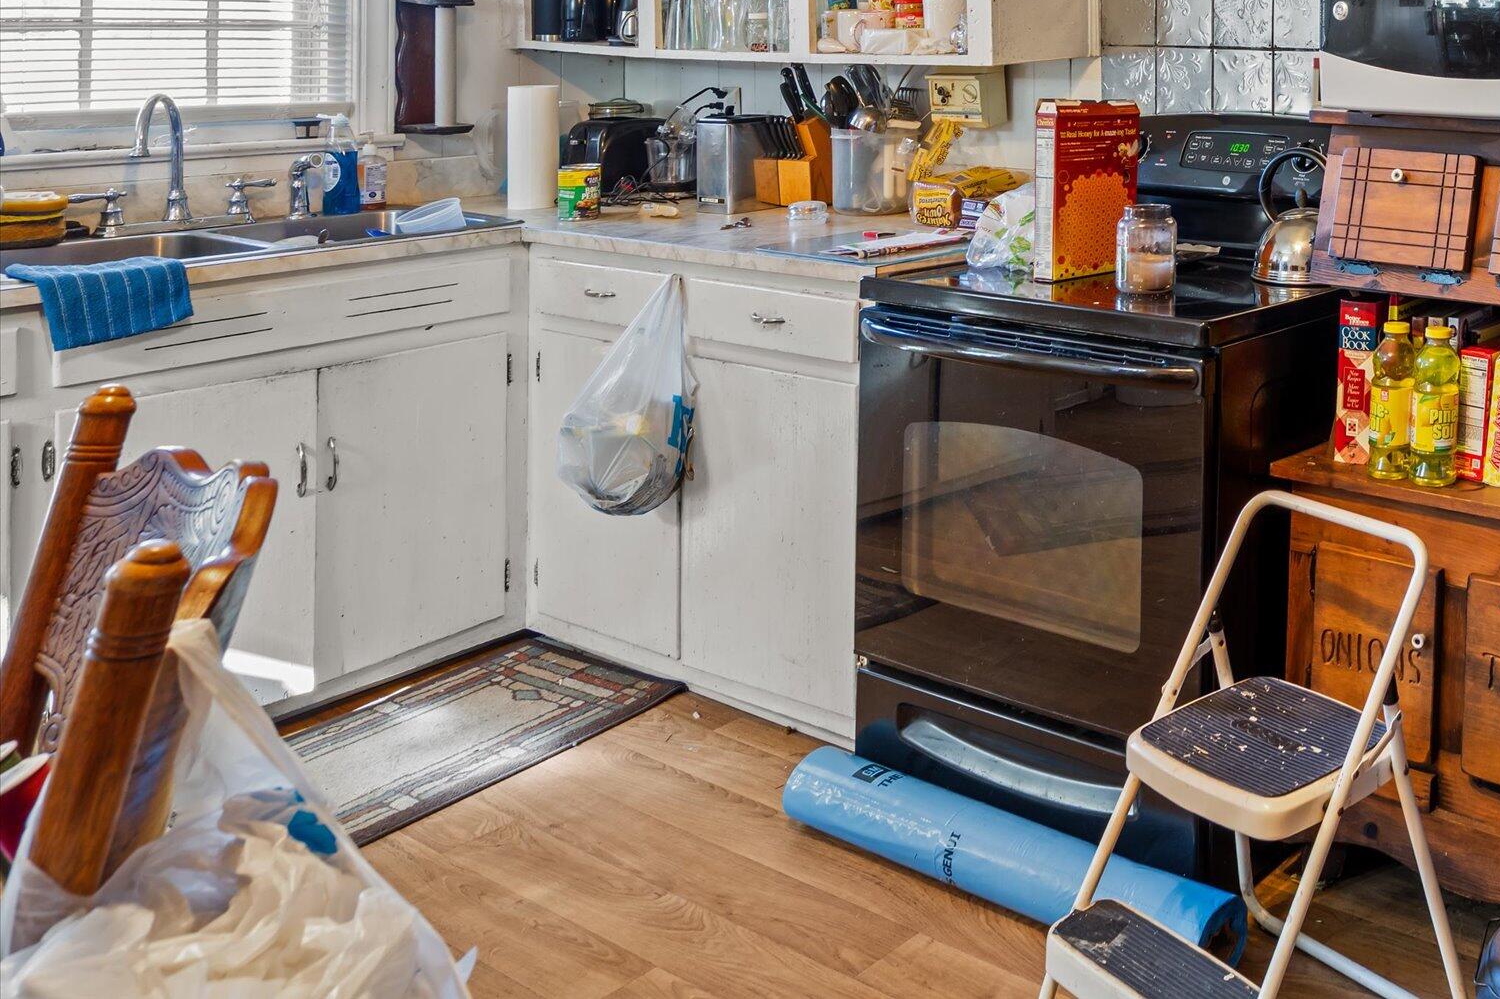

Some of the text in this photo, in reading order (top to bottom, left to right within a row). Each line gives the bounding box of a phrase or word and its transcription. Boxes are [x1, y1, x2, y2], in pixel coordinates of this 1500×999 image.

[1078, 131, 1093, 139] Honey
[923, 204, 943, 218] Own
[1341, 327, 1371, 341] COOK
[1342, 337, 1371, 351] BOOK
[1432, 423, 1454, 441] Sol
[878, 772, 905, 788] THE
[942, 831, 962, 878] GENUI
